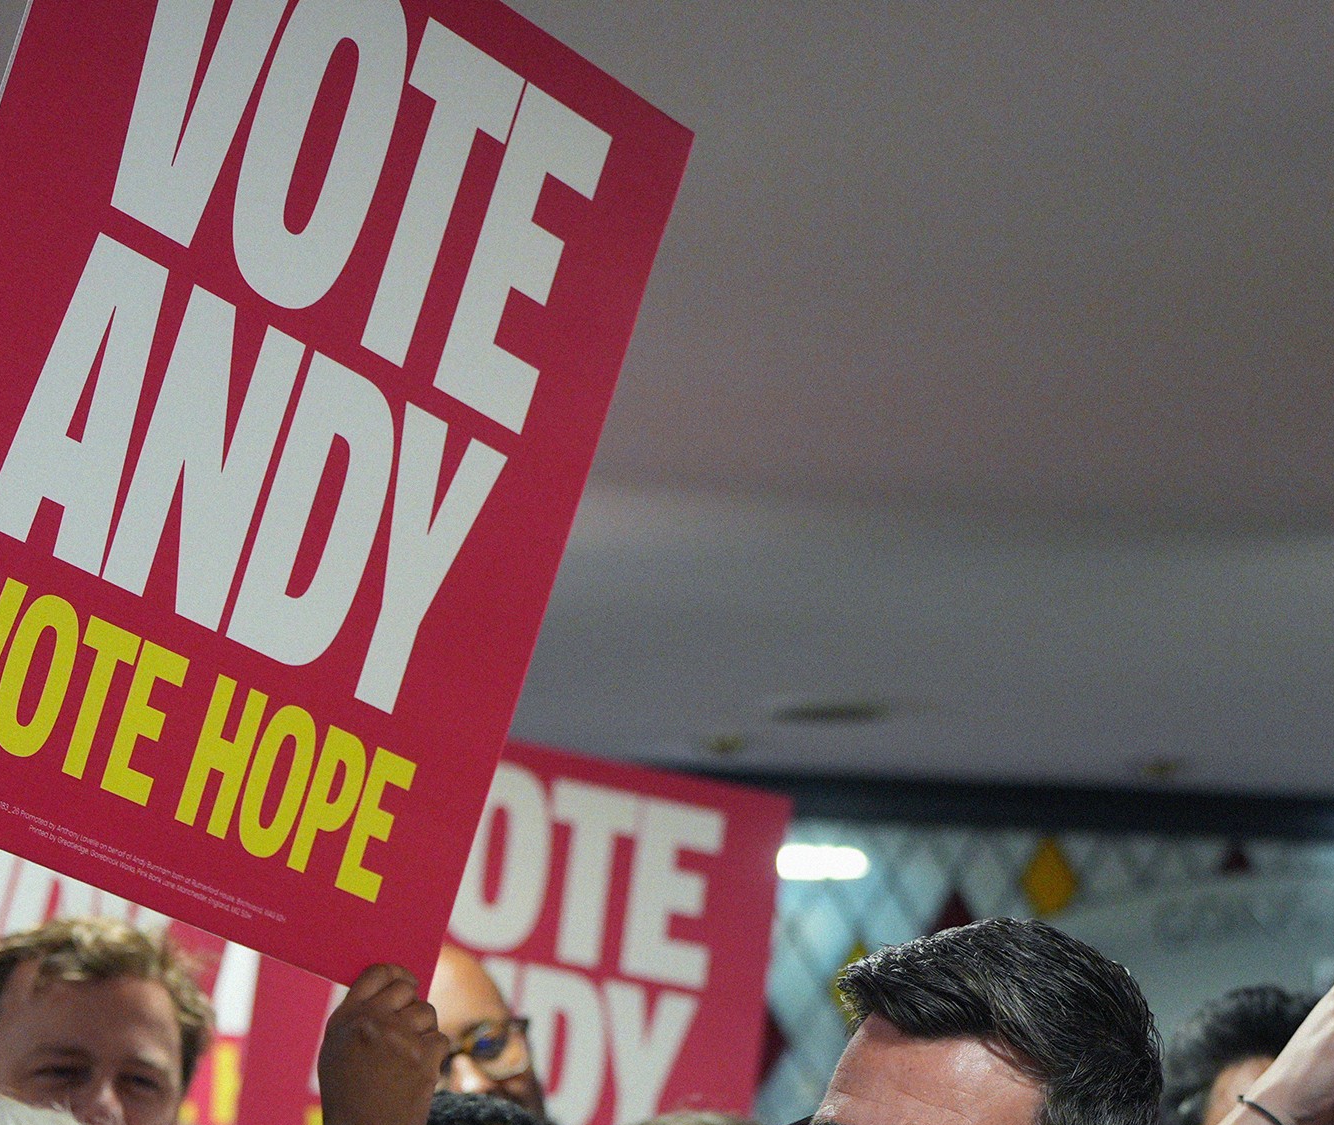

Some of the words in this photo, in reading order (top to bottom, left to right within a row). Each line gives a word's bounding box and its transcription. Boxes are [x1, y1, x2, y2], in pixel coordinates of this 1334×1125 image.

[110, 0, 613, 435] VOTE
[21, 810, 48, 826] Promoted
[48, 822, 56, 831] by
[57, 825, 80, 840] Anthony
[108, 846, 126, 857] behalf
[132, 856, 147, 867] Andy
[29, 825, 48, 837] Printed
[49, 834, 56, 842] by
[175, 675, 416, 904] HOPE
[448, 762, 727, 990] OTE
